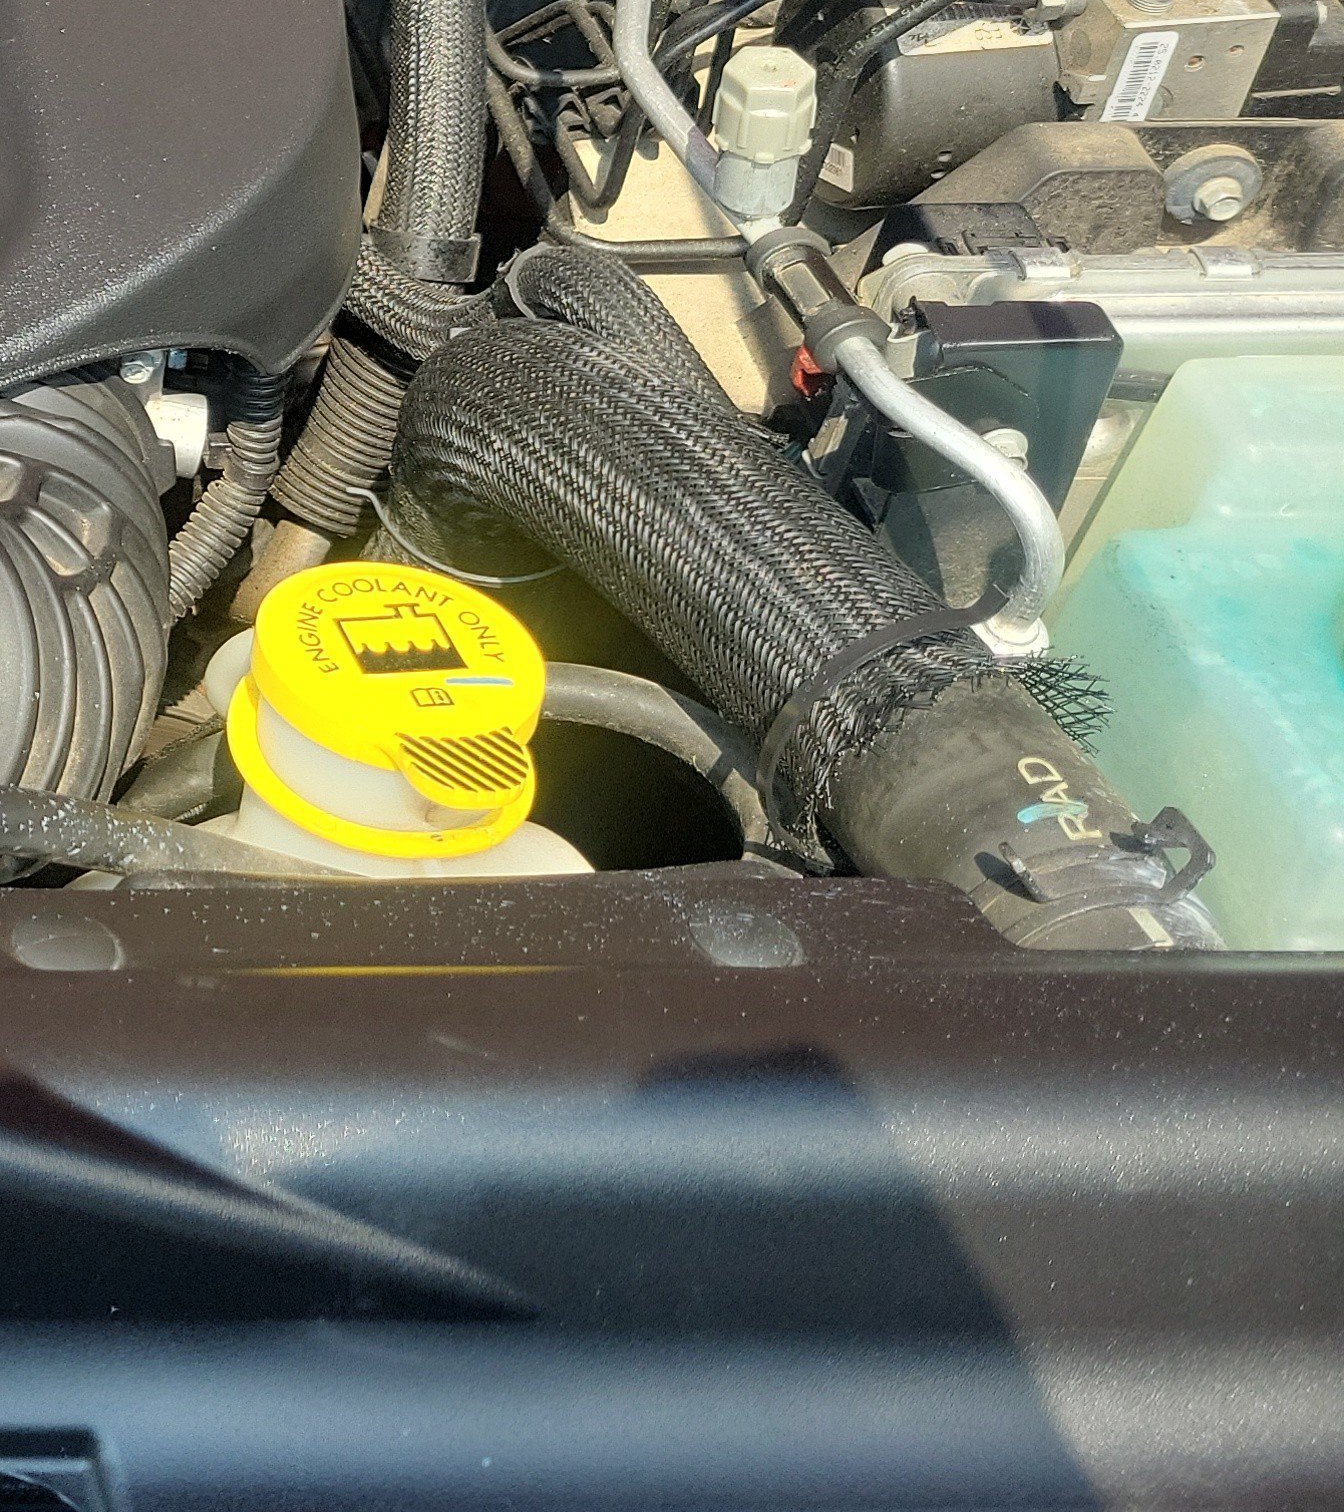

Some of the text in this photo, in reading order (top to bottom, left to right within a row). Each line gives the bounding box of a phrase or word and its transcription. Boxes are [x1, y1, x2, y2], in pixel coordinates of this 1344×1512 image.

[295, 577, 506, 675] ENGINE COOLANT ONLY
[1017, 756, 1102, 842] RAD
